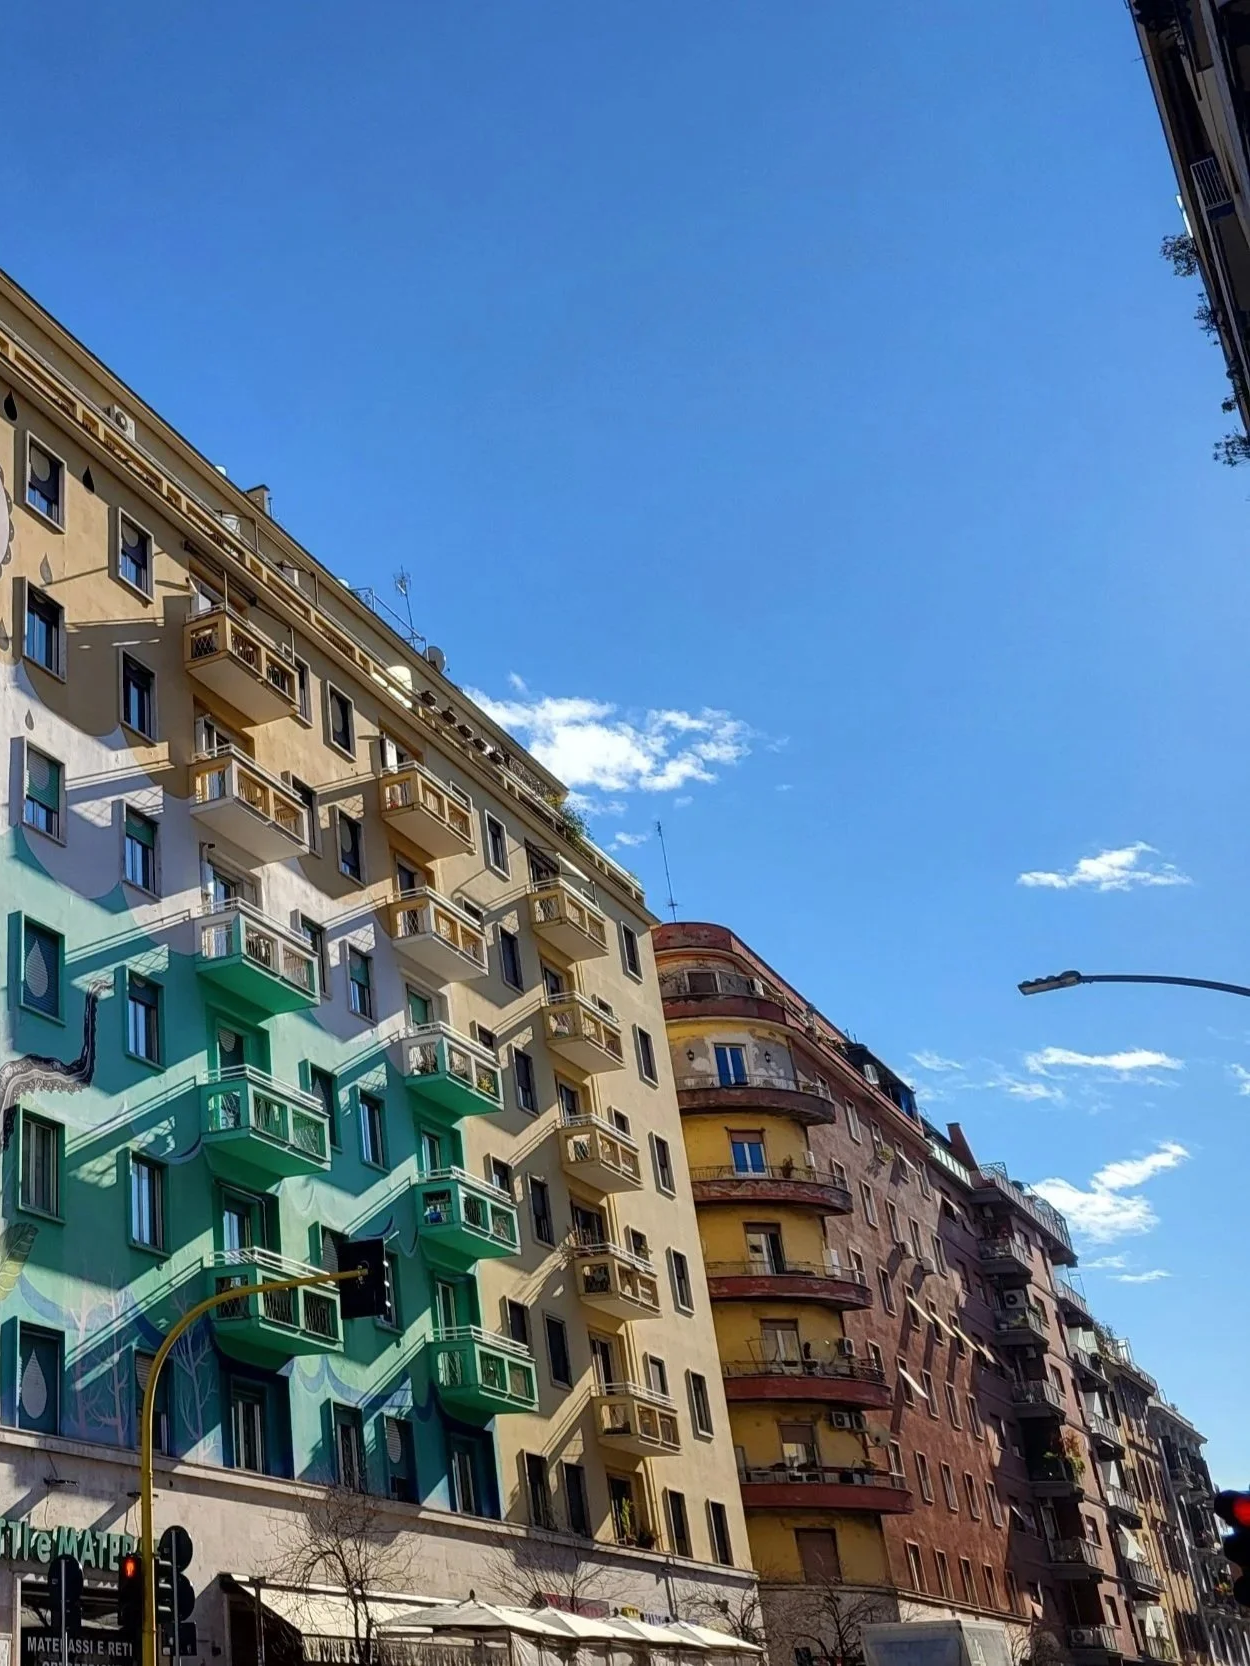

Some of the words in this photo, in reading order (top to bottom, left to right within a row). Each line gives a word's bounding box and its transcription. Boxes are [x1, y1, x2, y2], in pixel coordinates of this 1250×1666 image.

[35, 1531, 52, 1564] e
[97, 1641, 104, 1655] E
[108, 1641, 133, 1657] RETI
